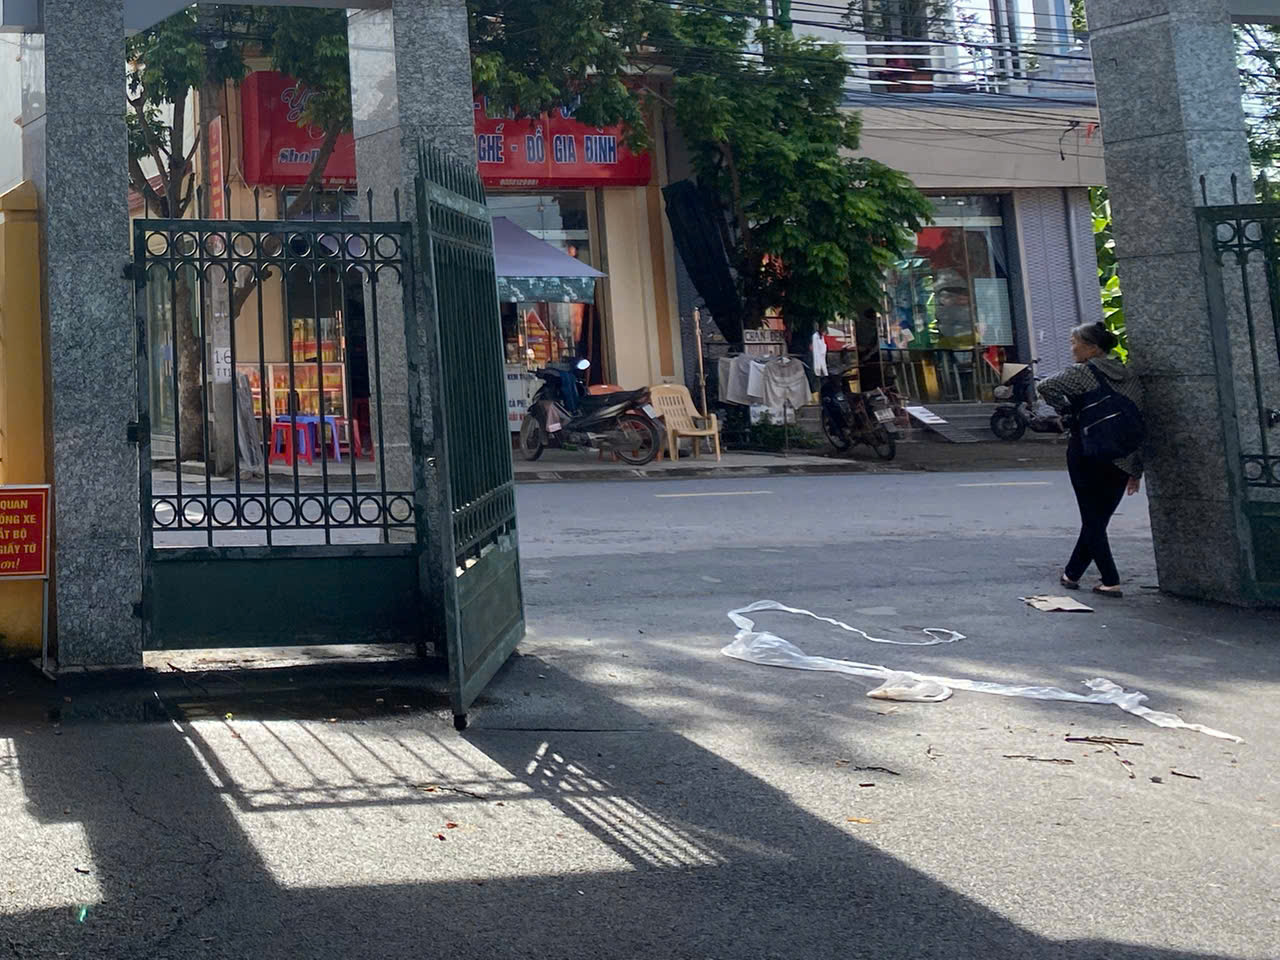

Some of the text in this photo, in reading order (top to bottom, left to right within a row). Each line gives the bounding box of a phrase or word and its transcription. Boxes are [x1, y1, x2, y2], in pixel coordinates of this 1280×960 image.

[478, 123, 504, 163] GHẾ
[553, 134, 577, 164] GIA
[584, 128, 617, 164] ĐÌNH
[0, 499, 28, 510] QUAN
[23, 514, 37, 524] XE
